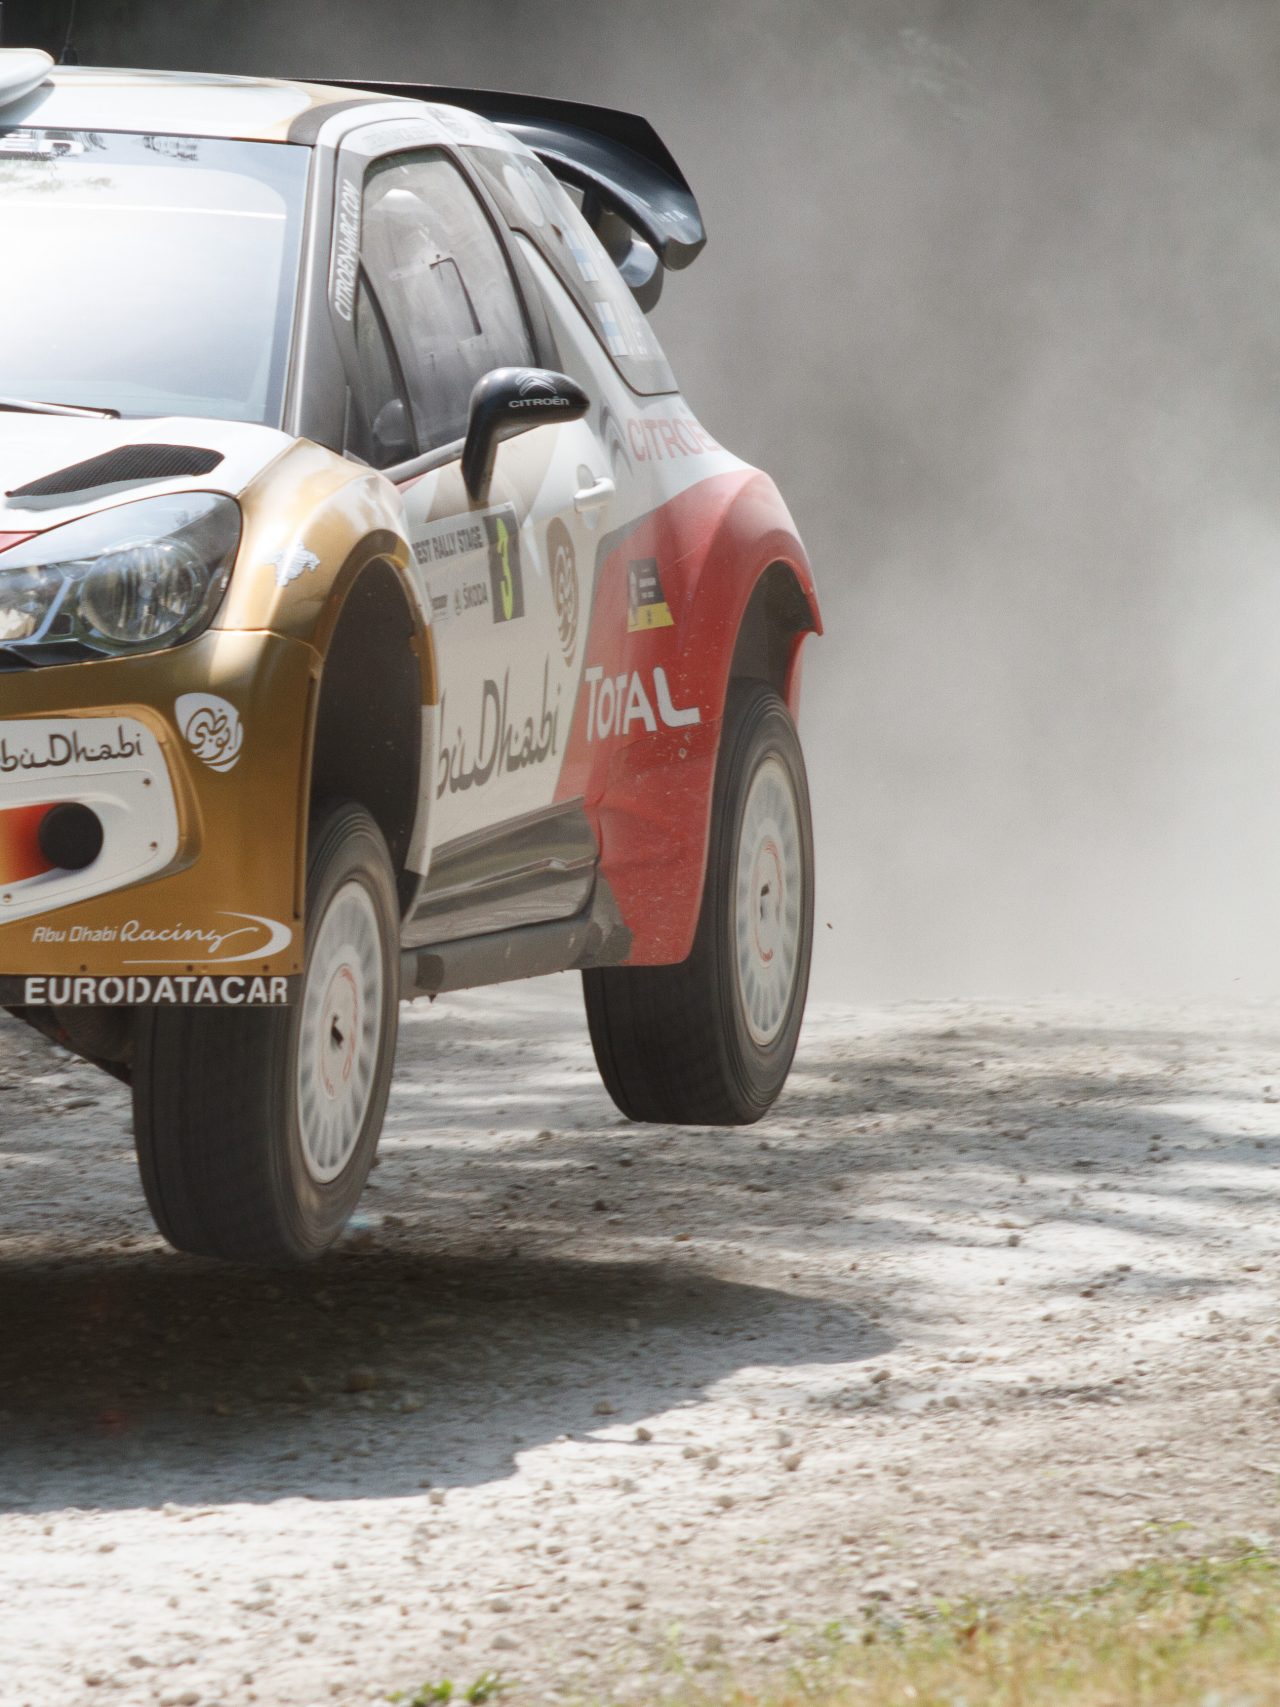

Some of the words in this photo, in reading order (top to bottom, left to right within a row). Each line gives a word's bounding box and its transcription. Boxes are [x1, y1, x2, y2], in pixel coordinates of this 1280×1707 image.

[495, 517, 513, 620] 3
[473, 653, 561, 787] Dhabi
[584, 665, 700, 743] TOTAL
[32, 926, 65, 942] Abu
[68, 926, 118, 942] Dhabi
[120, 919, 259, 953] Racing
[24, 976, 288, 1004] EURODATACAR
